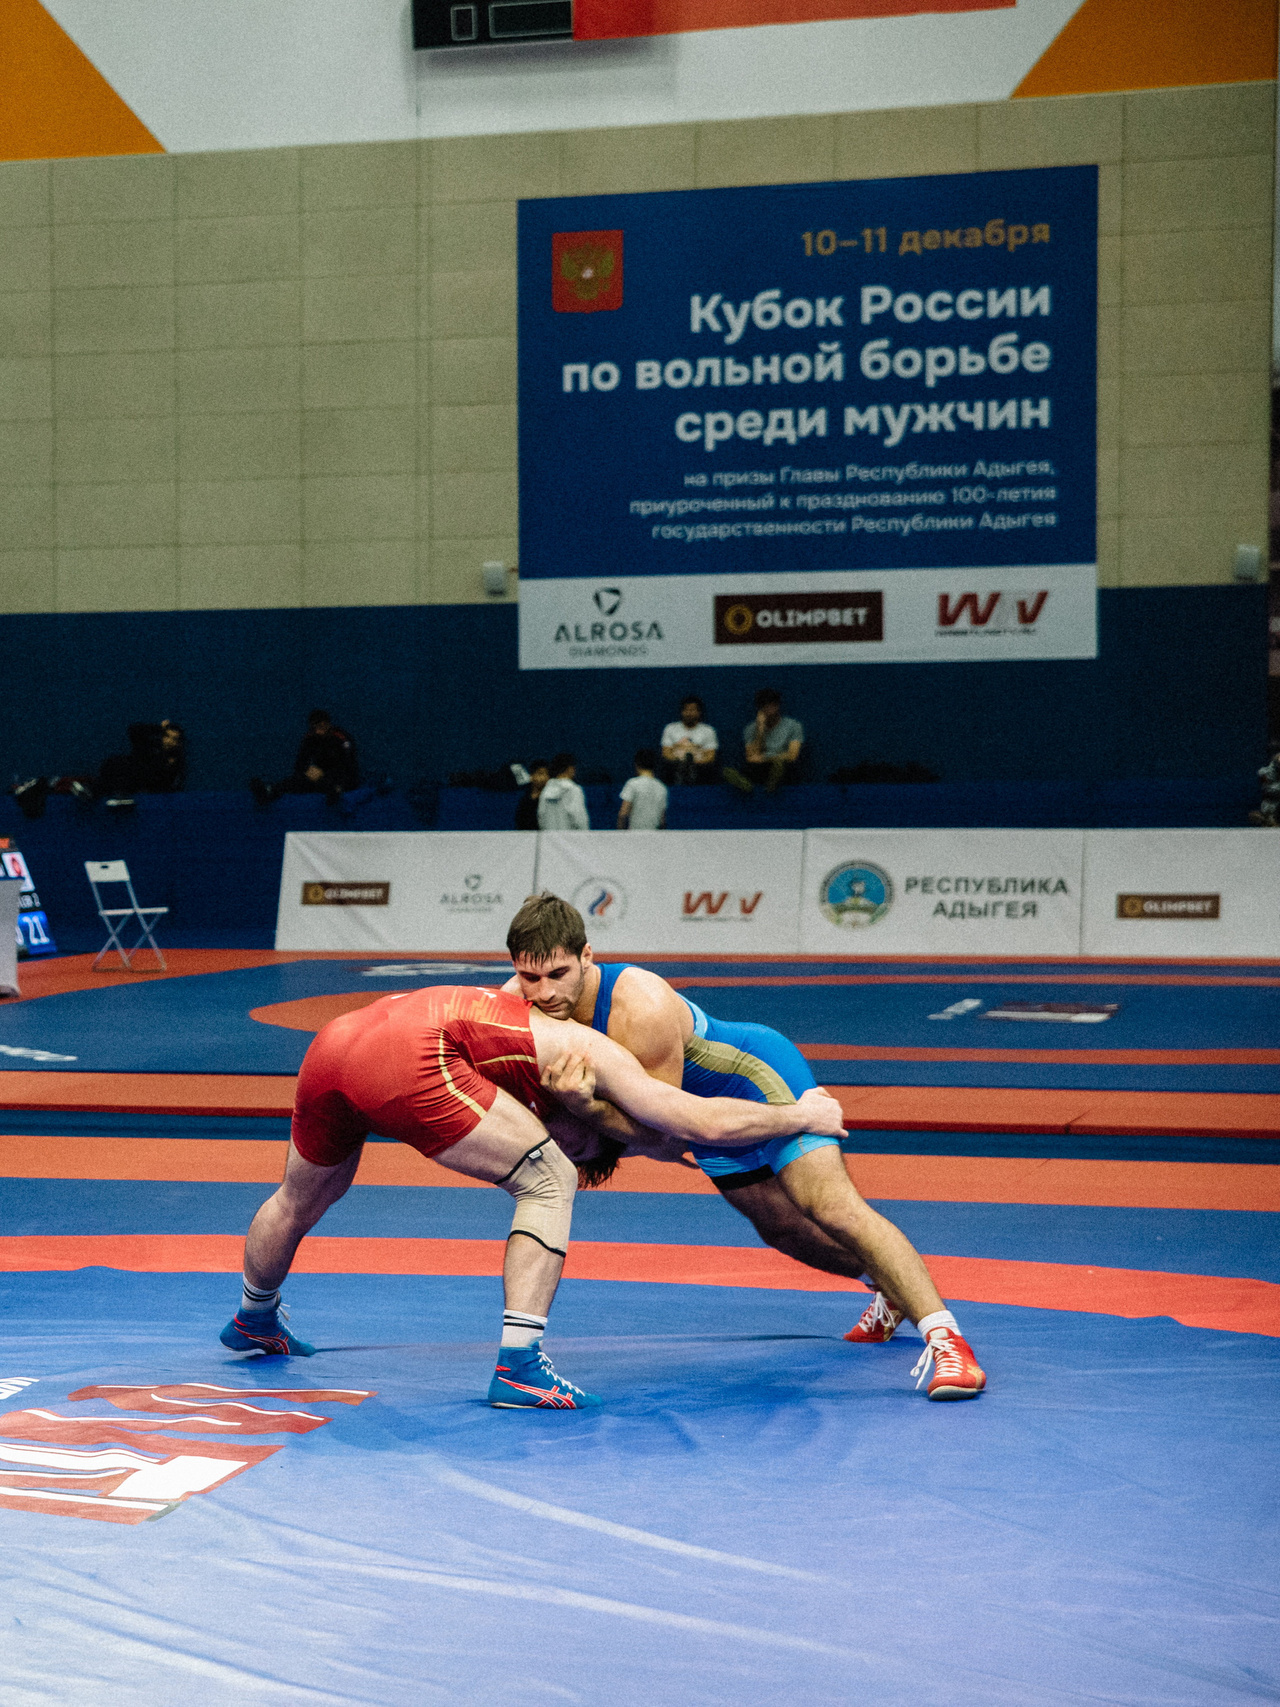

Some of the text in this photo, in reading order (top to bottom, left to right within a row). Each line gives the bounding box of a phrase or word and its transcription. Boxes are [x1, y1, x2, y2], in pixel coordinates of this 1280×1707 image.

[899, 219, 1051, 254] декабря
[690, 286, 1051, 344] Кубок России
[563, 333, 1051, 392] по вольной борьбе
[675, 398, 1051, 451] среди мужчин
[683, 473, 709, 487] на
[712, 471, 776, 490] призы
[779, 466, 841, 484] Главы
[845, 462, 969, 484] Республики
[629, 485, 1057, 518] приуроченный к празднованию 100-летия
[651, 512, 1057, 542] государственности Республики Адыгея
[554, 621, 665, 642] ALROSA
[755, 607, 869, 628] OLIMPBET
[905, 876, 1069, 896] РЕСПУБЛИКА
[932, 901, 1039, 920] АДЫГЕЯ
